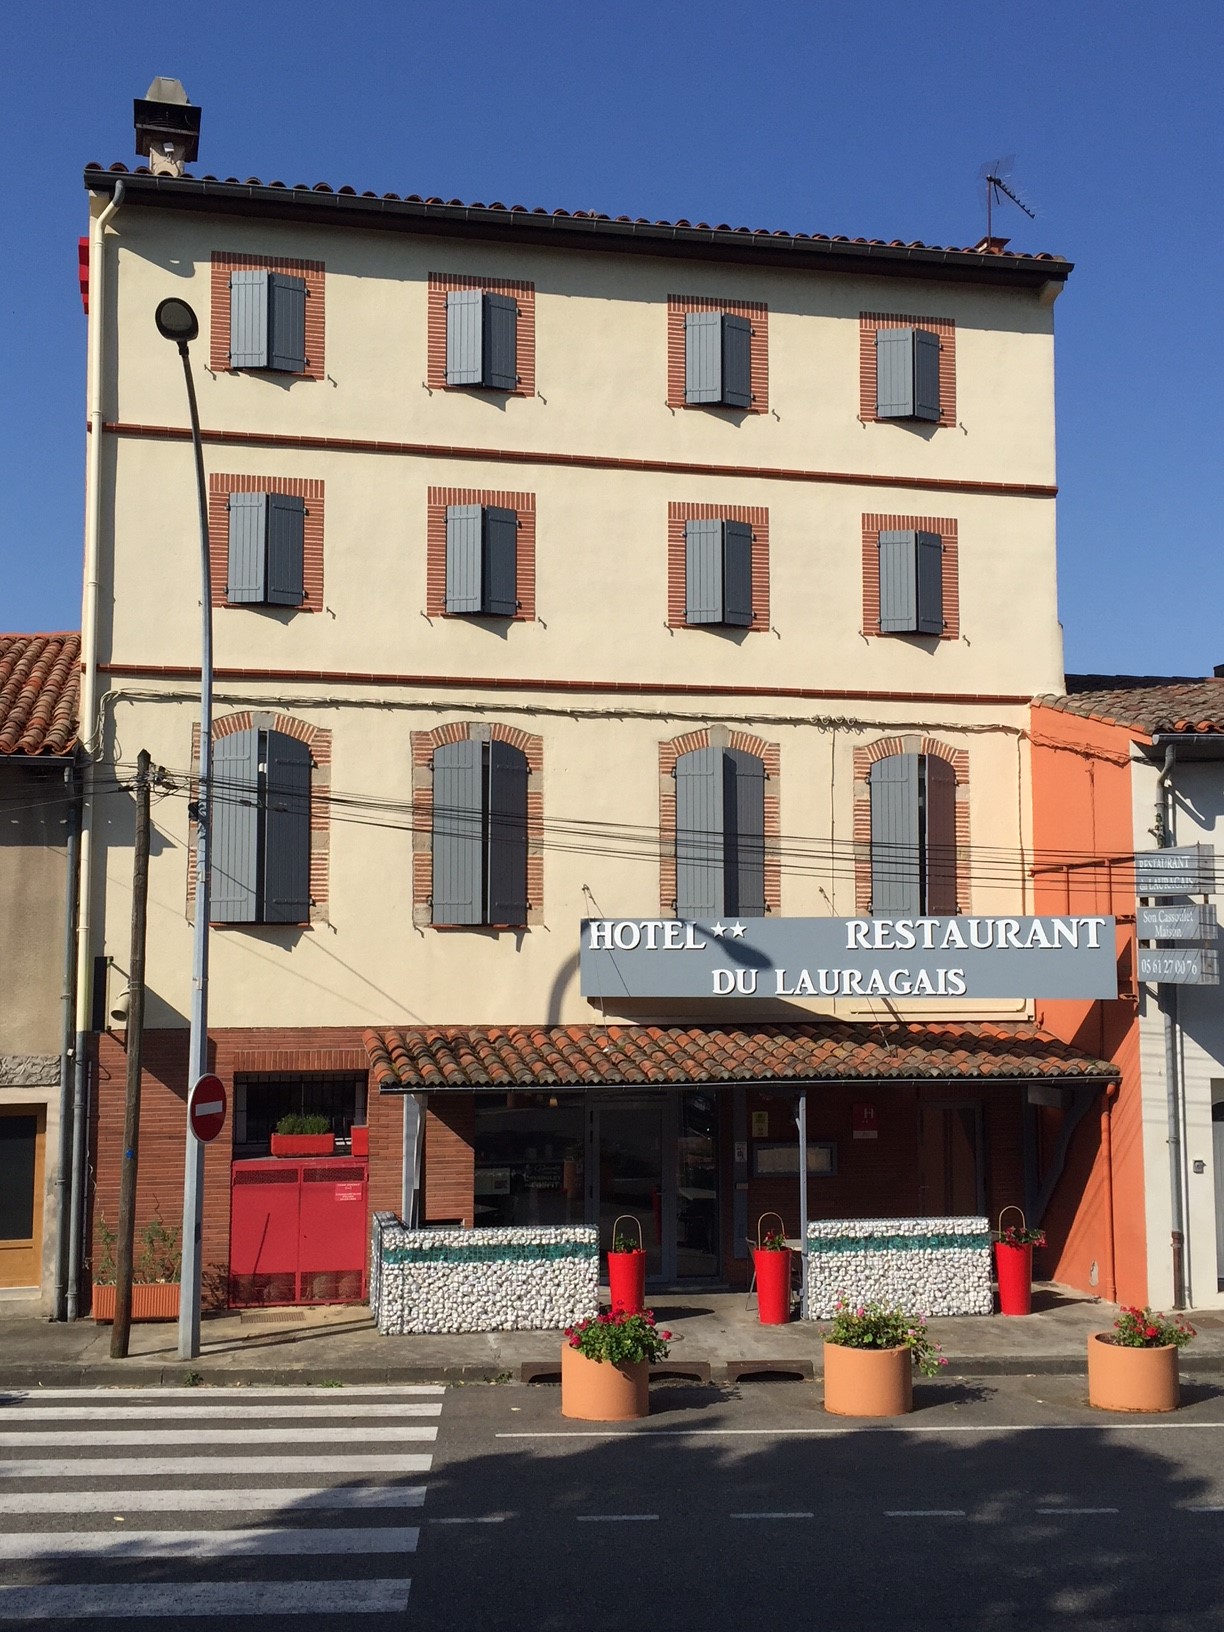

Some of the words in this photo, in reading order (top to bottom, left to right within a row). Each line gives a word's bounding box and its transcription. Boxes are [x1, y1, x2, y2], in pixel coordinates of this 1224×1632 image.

[1138, 856, 1190, 871] RESTAURANT
[1143, 911, 1156, 923] Son
[1158, 909, 1194, 923] Cassoulet
[588, 921, 706, 950] HOTEL
[845, 918, 1106, 949] RESTAURANT
[1154, 925, 1182, 938] Maison
[712, 969, 759, 995] DU
[775, 968, 966, 996] LAURAGAIS
